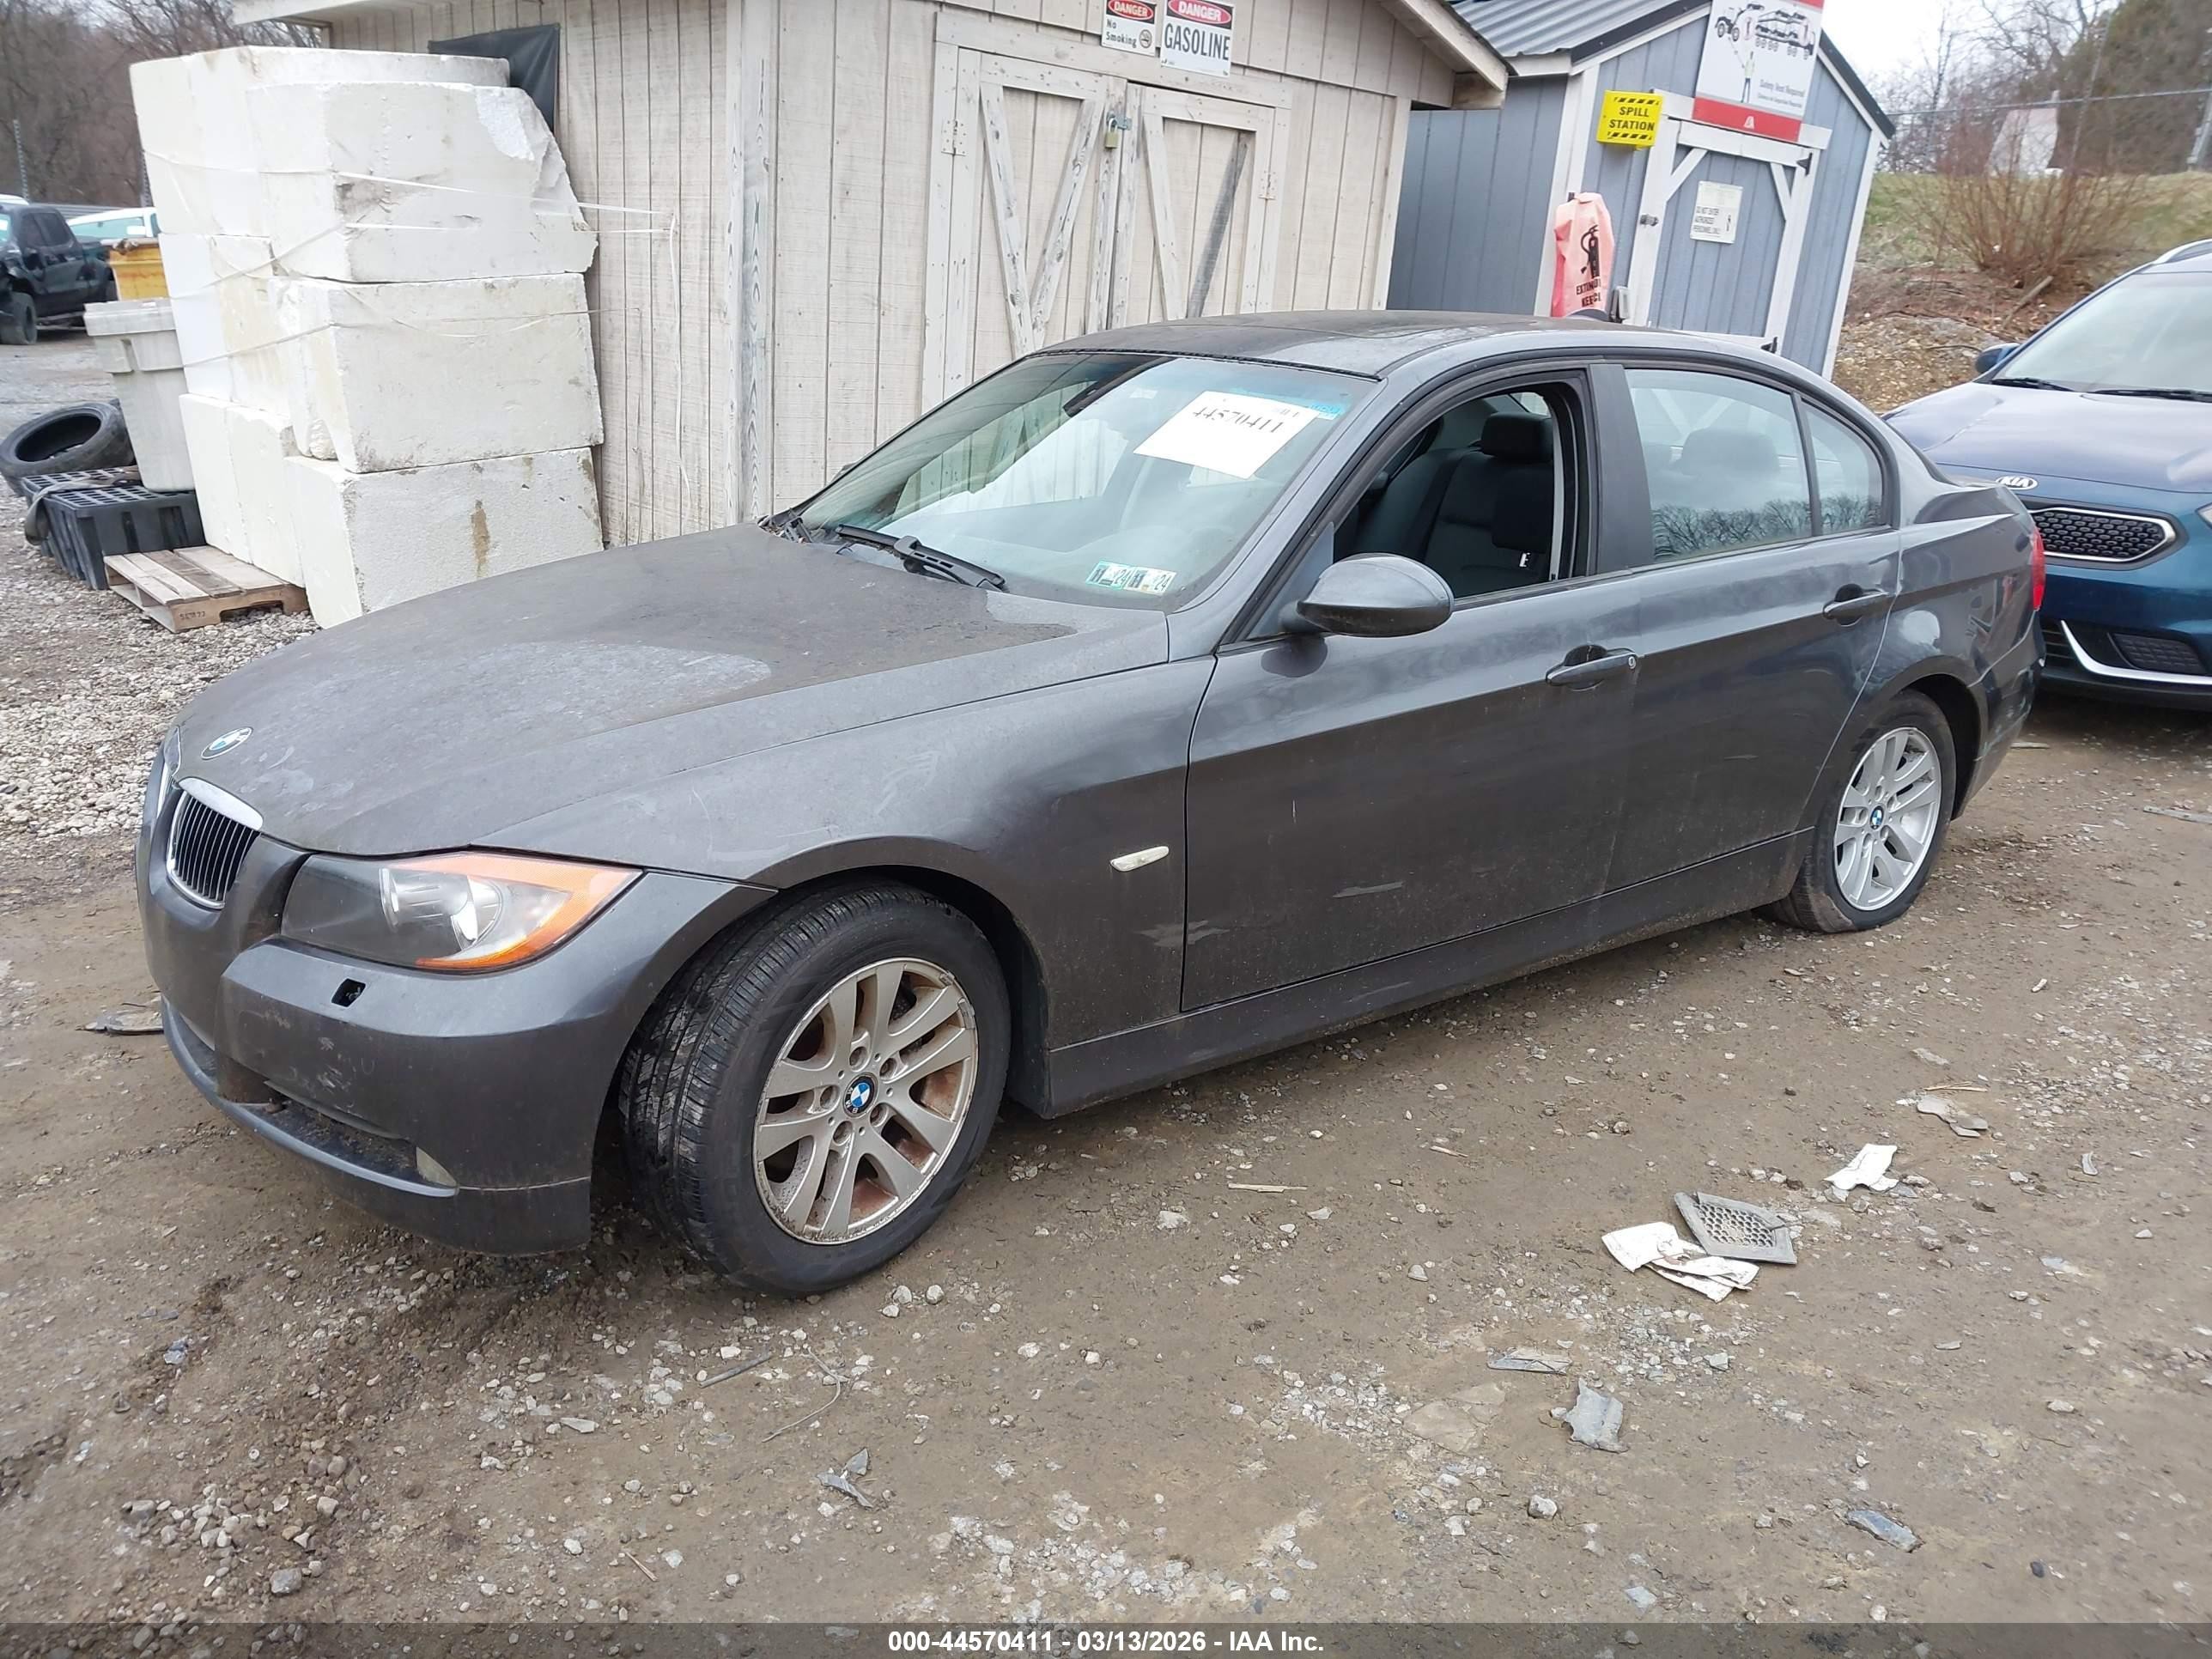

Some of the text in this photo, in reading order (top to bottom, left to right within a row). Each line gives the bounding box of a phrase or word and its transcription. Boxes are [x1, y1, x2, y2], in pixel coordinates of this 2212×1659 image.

[1114, 1, 1149, 17] DANGER
[1178, 1, 1222, 22] DANGER
[1107, 19, 1117, 28] No
[1106, 31, 1137, 48] Smoking
[1164, 22, 1231, 61] GASOLINE
[1619, 106, 1650, 118] SPILL
[1608, 118, 1656, 131] STATION
[1193, 406, 1285, 434] 44570411
[1999, 476, 2032, 489] KIA
